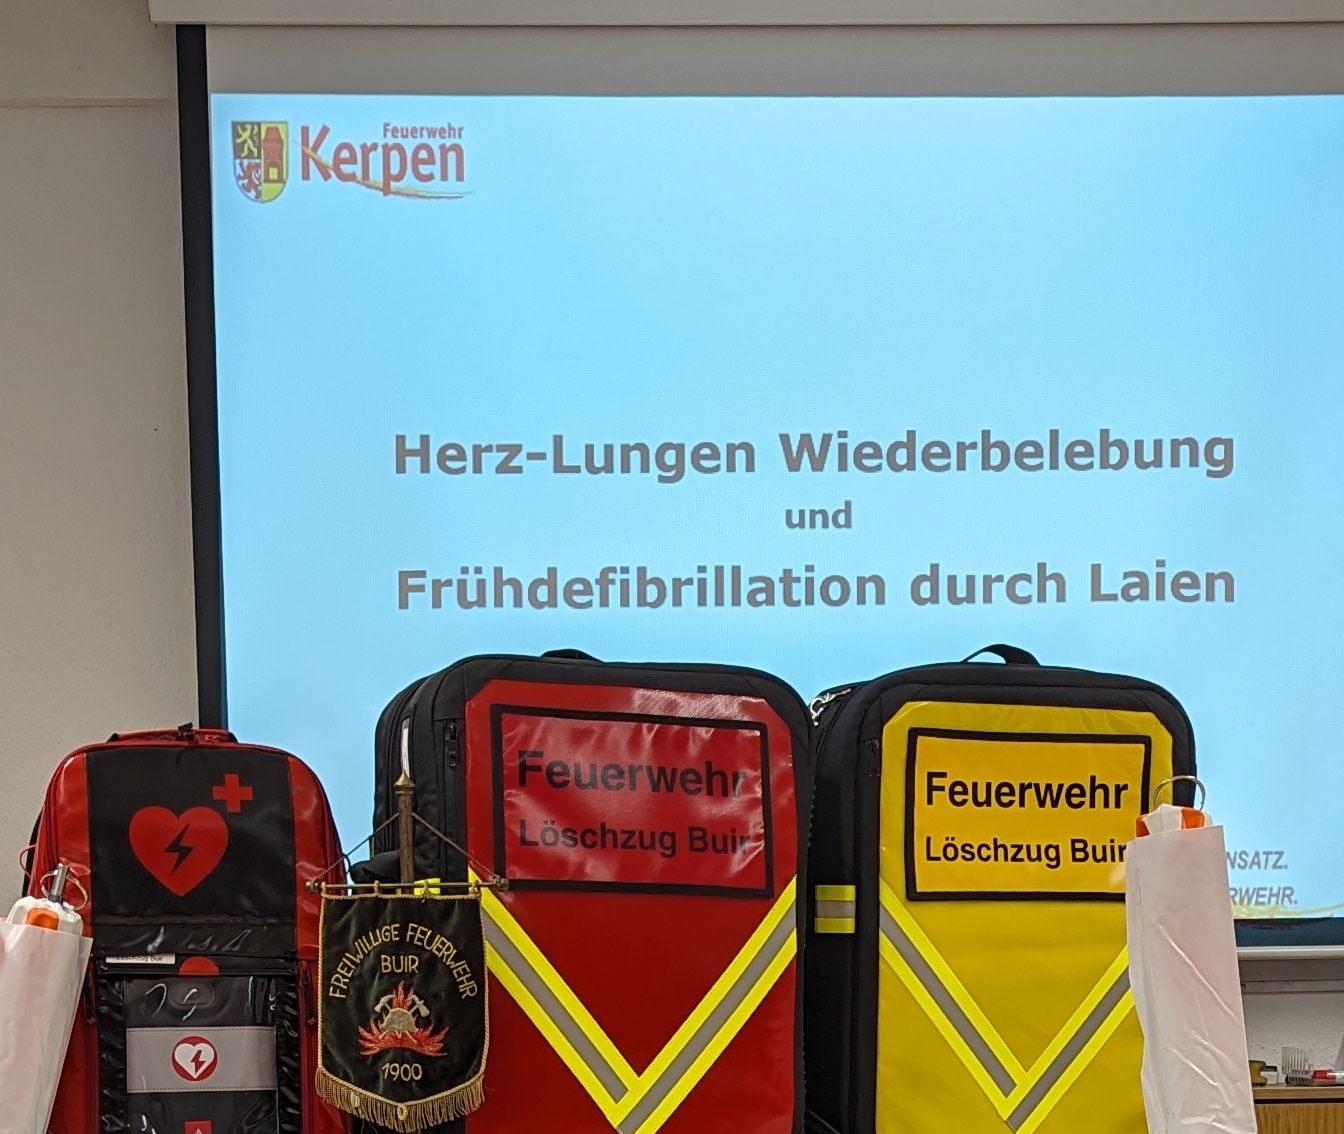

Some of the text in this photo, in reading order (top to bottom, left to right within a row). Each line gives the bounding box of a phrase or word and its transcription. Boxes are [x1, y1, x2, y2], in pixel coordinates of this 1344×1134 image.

[382, 122, 464, 140] Feuerwehr
[300, 124, 465, 196] Kerpen
[395, 428, 1235, 484] Herz-Lungen Wiederbelebung
[784, 500, 853, 530] und
[397, 558, 1235, 610] Frühdefibrillation durch Laien
[517, 749, 748, 799] Feuerwehr
[925, 771, 1128, 810] Feuerwehr
[518, 818, 751, 859] Löschzug Buir
[925, 836, 1127, 869] Löschzug Buir
[328, 922, 479, 999] FREIWILLIGE FEUERWEHR
[379, 954, 420, 974] BUIR
[381, 1062, 424, 1082] 1900
